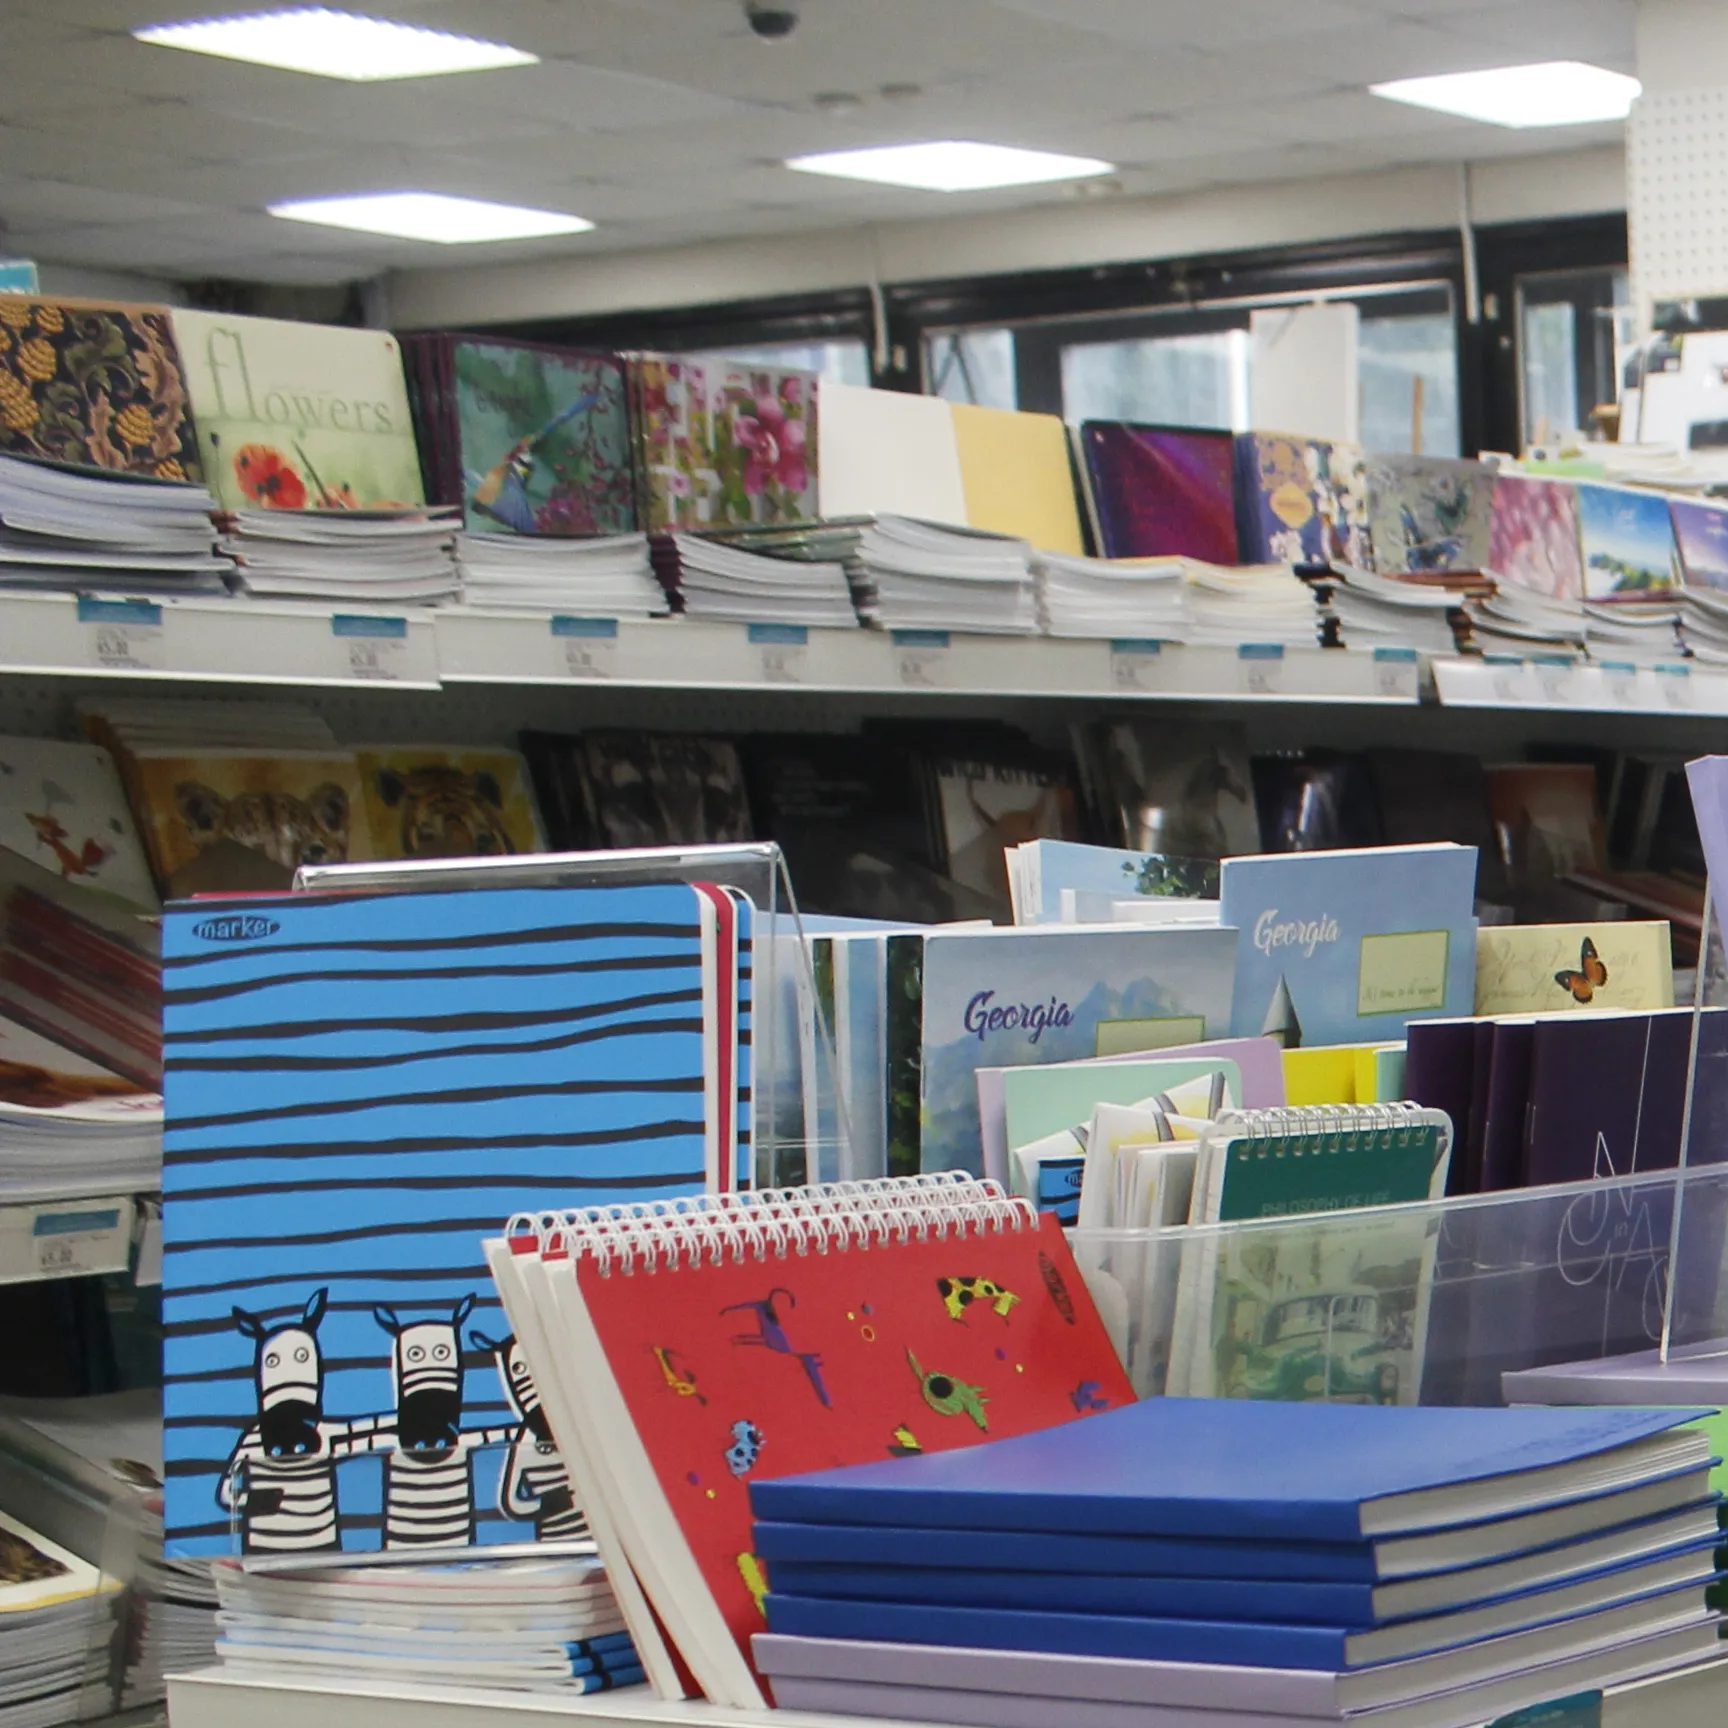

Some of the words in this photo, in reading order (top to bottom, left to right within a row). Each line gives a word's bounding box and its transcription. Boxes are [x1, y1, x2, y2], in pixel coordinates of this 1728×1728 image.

[203, 326, 396, 437] flowers
[198, 916, 274, 939] marker
[1254, 908, 1342, 958] Georgia
[963, 989, 1076, 1045] Georgia
